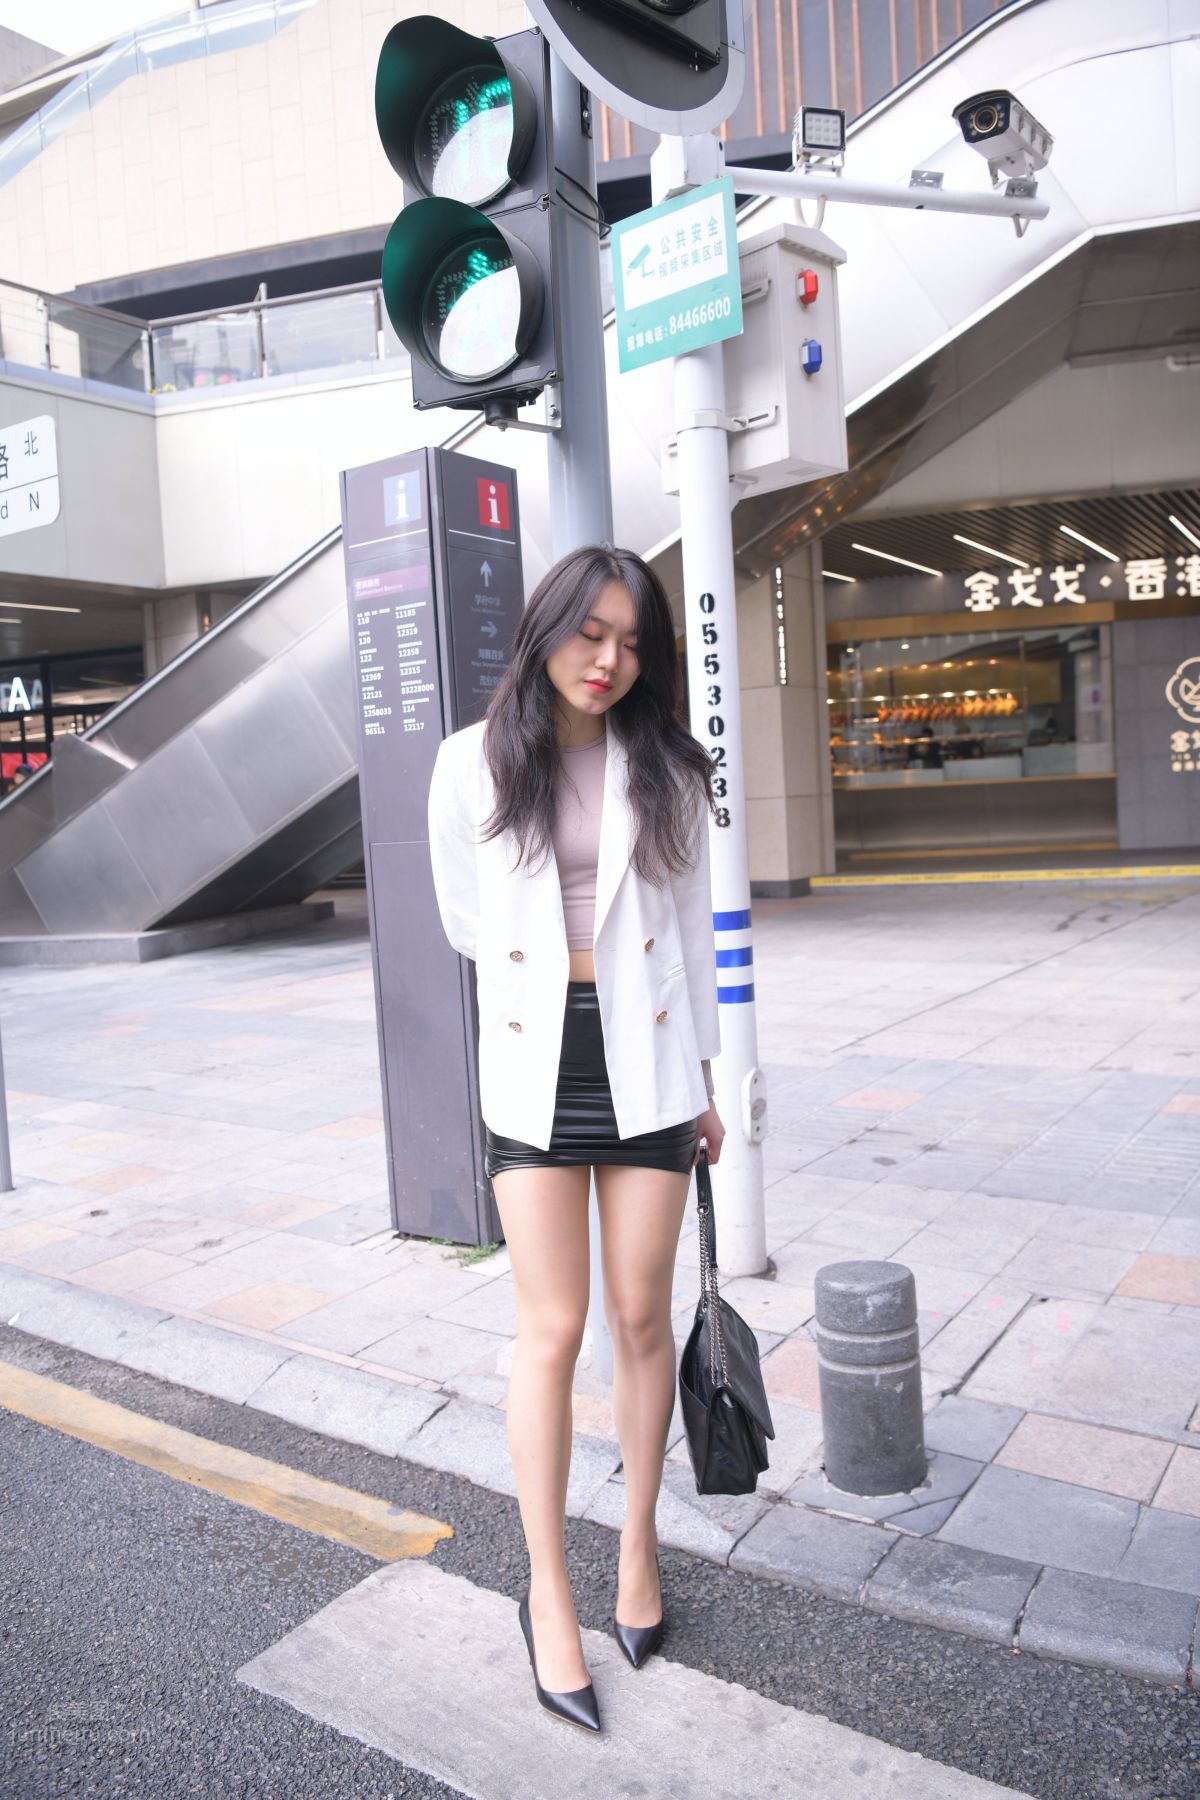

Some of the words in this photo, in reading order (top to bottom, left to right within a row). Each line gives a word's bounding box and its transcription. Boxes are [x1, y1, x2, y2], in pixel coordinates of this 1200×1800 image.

[661, 216, 719, 255] 公共安全
[24, 431, 39, 456] 北
[29, 491, 40, 512] N
[395, 608, 416, 619] 11185
[357, 616, 370, 625] 110
[397, 627, 418, 637] 12319
[359, 637, 371, 645] 120
[360, 654, 372, 663] 122
[400, 666, 421, 676] 12315
[361, 672, 382, 682] 12369
[363, 690, 383, 700] 12121
[403, 704, 415, 713] 114
[699, 592, 731, 828] 05530238
[365, 727, 385, 736] 96511
[404, 722, 425, 732] 12117
